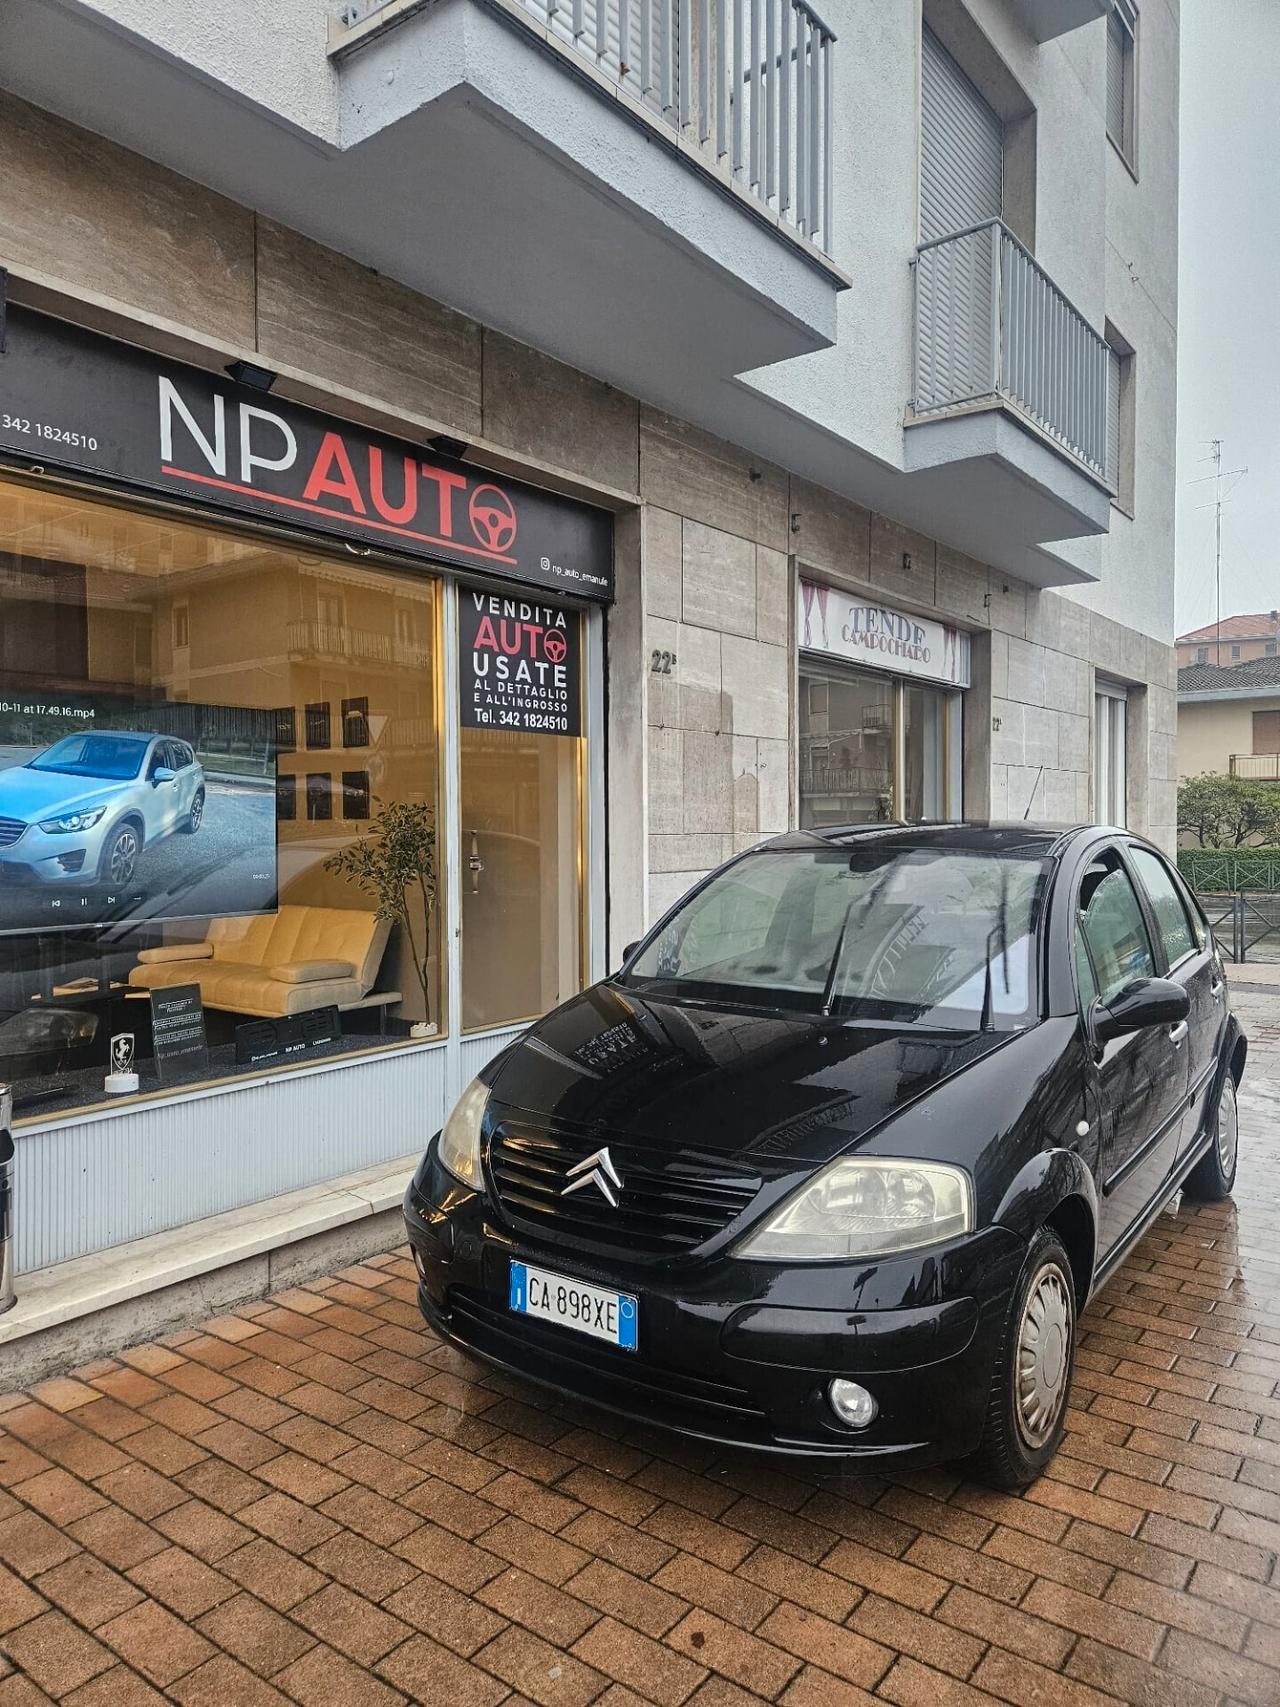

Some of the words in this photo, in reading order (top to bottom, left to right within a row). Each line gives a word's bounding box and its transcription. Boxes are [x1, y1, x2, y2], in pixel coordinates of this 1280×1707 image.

[2, 414, 31, 434] 342
[35, 423, 98, 451] 1824510
[472, 592, 567, 629] VENDITA
[473, 651, 567, 688] USATE
[474, 678, 491, 691] AL
[497, 681, 568, 700] DETTAGLIO
[23, 705, 34, 714] at
[36, 705, 95, 719] 17.49.16.mp4
[474, 692, 481, 702] E
[486, 694, 568, 713] ALL'INGROSSO
[474, 707, 496, 724] Tel.
[499, 710, 520, 727] 342
[523, 713, 568, 731] 1824510
